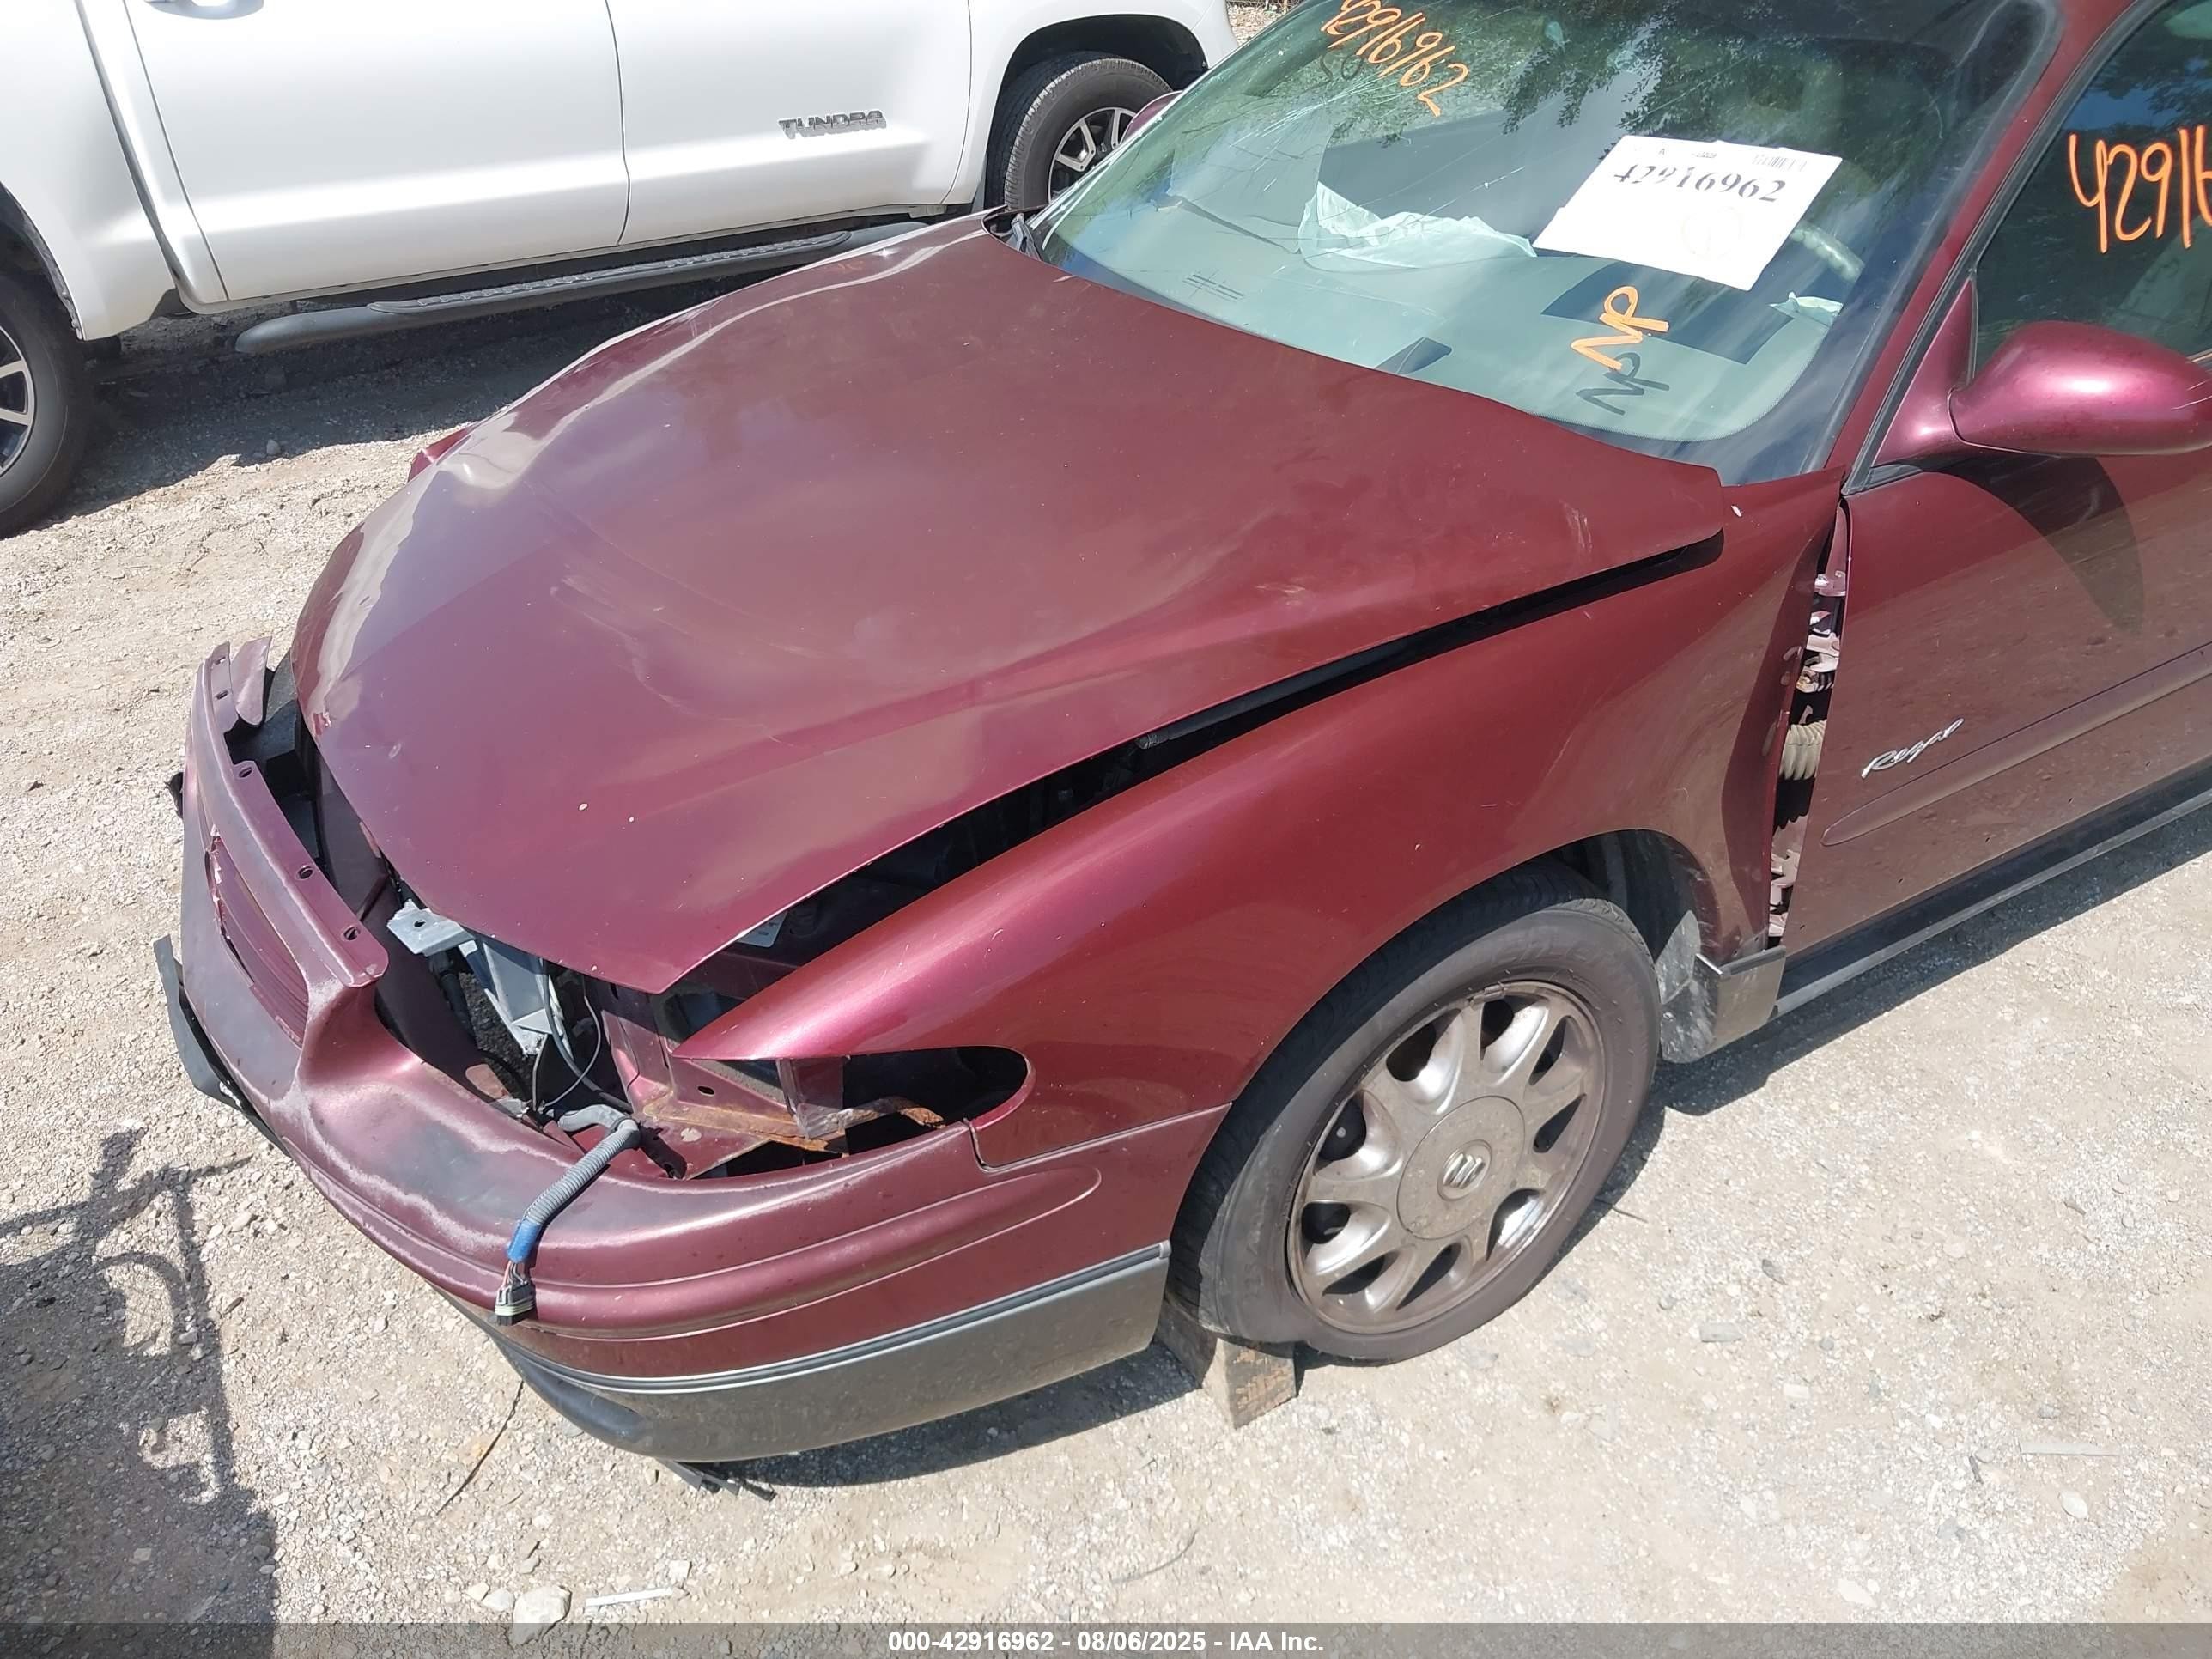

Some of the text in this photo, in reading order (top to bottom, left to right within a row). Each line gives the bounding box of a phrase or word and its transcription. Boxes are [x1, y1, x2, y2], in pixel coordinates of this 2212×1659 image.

[778, 110, 887, 139] TUNDRA
[1613, 164, 1786, 203] 42916962
[1571, 285, 1670, 372] NP
[1861, 718, 1965, 779] Regal
